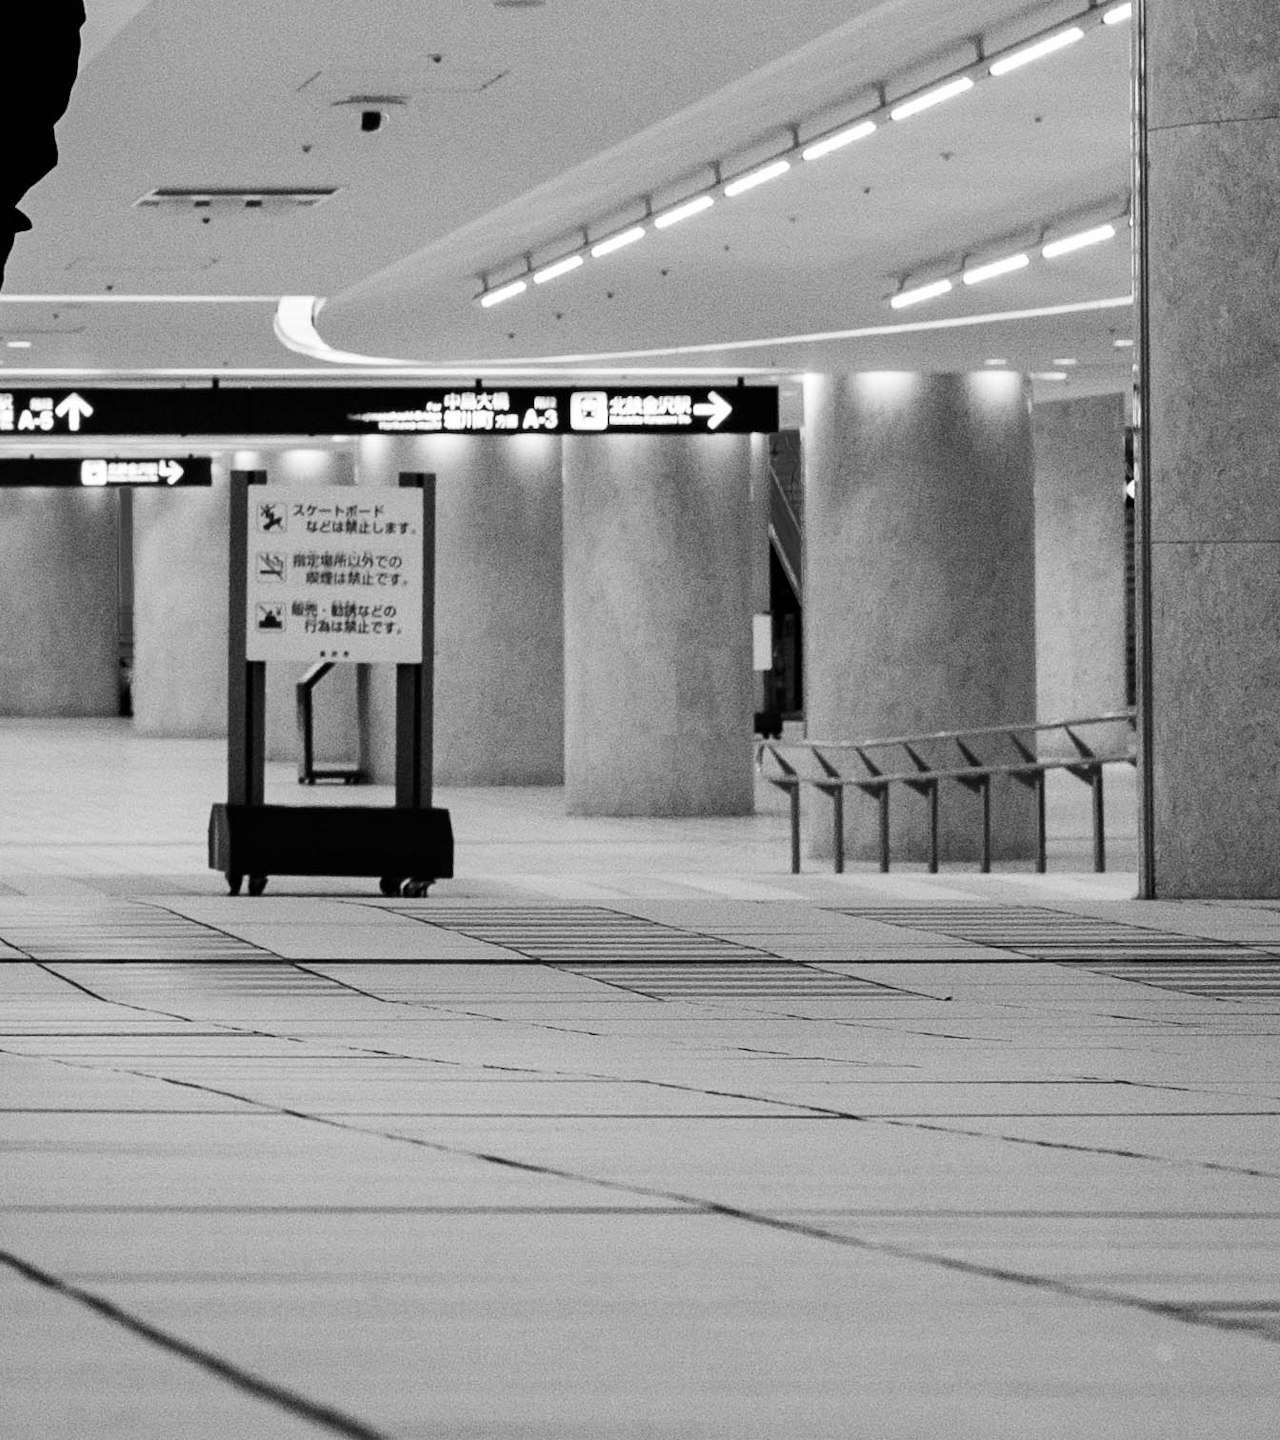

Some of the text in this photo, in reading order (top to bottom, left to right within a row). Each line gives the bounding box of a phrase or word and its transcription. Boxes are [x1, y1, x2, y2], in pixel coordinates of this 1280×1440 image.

[292, 504, 384, 519] スケートボード
[305, 518, 416, 535] などは禁止します。
[292, 551, 403, 569] 指定場所以外での
[305, 570, 408, 587] 喫煙は禁止です。
[304, 619, 402, 635] 行為は禁止です。
